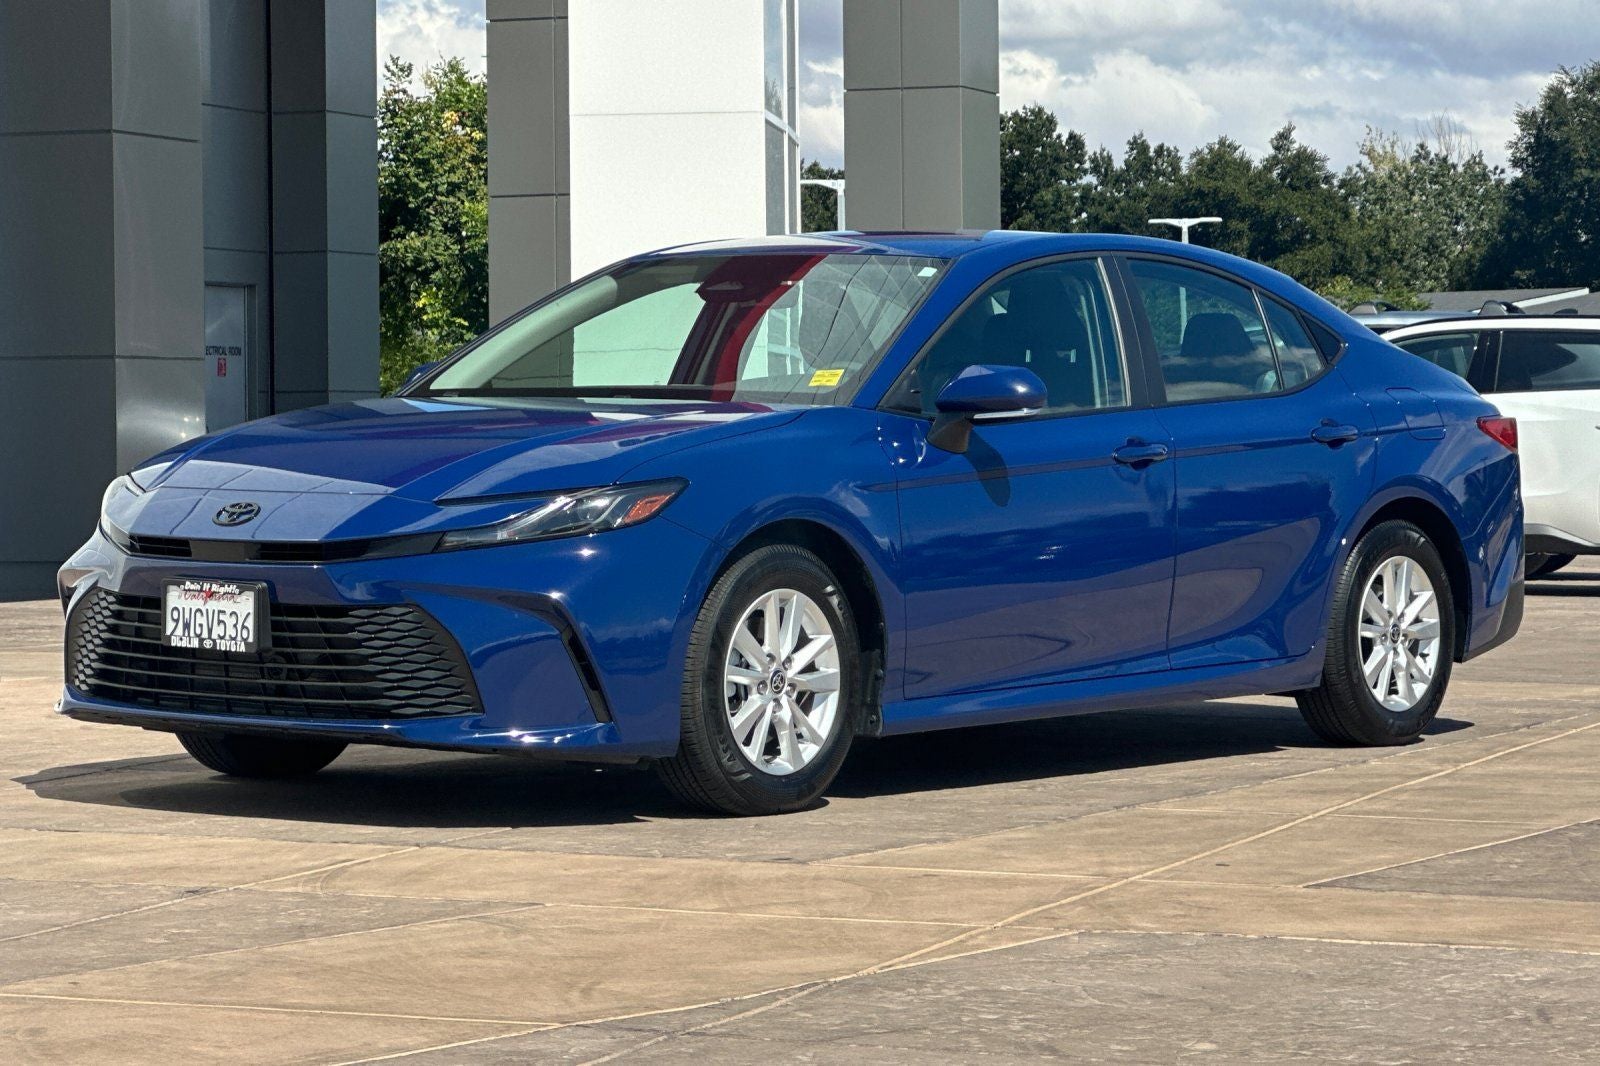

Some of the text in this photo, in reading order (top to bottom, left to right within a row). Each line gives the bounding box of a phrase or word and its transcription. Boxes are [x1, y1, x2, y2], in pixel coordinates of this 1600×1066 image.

[205, 345, 242, 356] ECTRICAL ROOM
[203, 583, 210, 592] It
[170, 606, 251, 642] 9WGV536
[170, 635, 246, 652] DUBLIN TOYOTA
